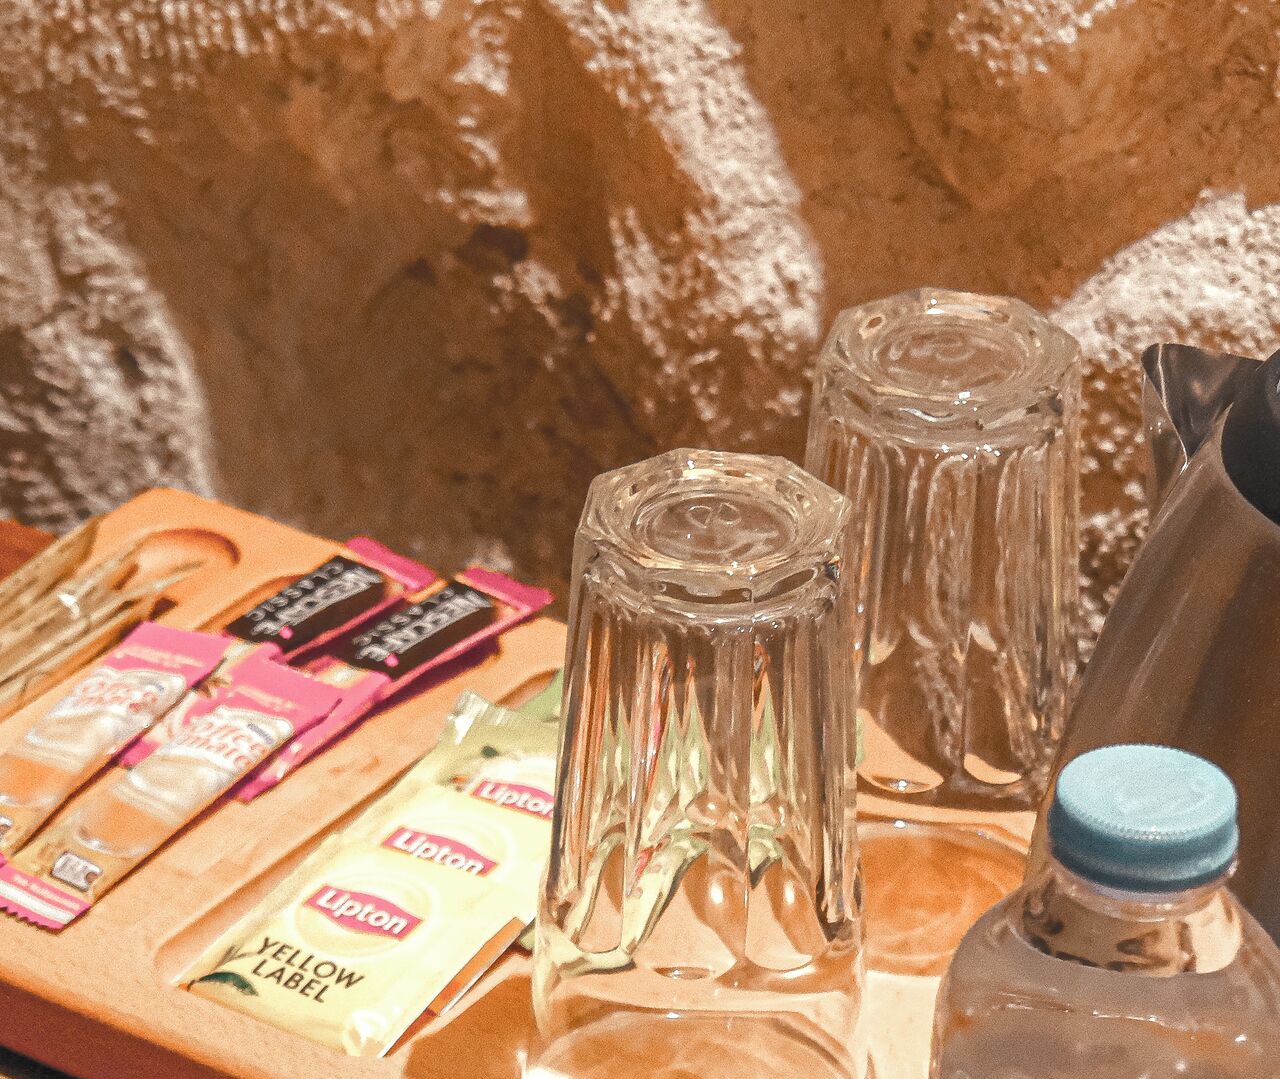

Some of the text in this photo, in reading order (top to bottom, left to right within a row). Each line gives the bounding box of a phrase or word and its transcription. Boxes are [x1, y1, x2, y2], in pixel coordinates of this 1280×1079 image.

[393, 831, 486, 876] Lipton
[315, 888, 410, 934] Lipton
[252, 959, 331, 1003] LABEL
[256, 936, 365, 989] YELLOW
